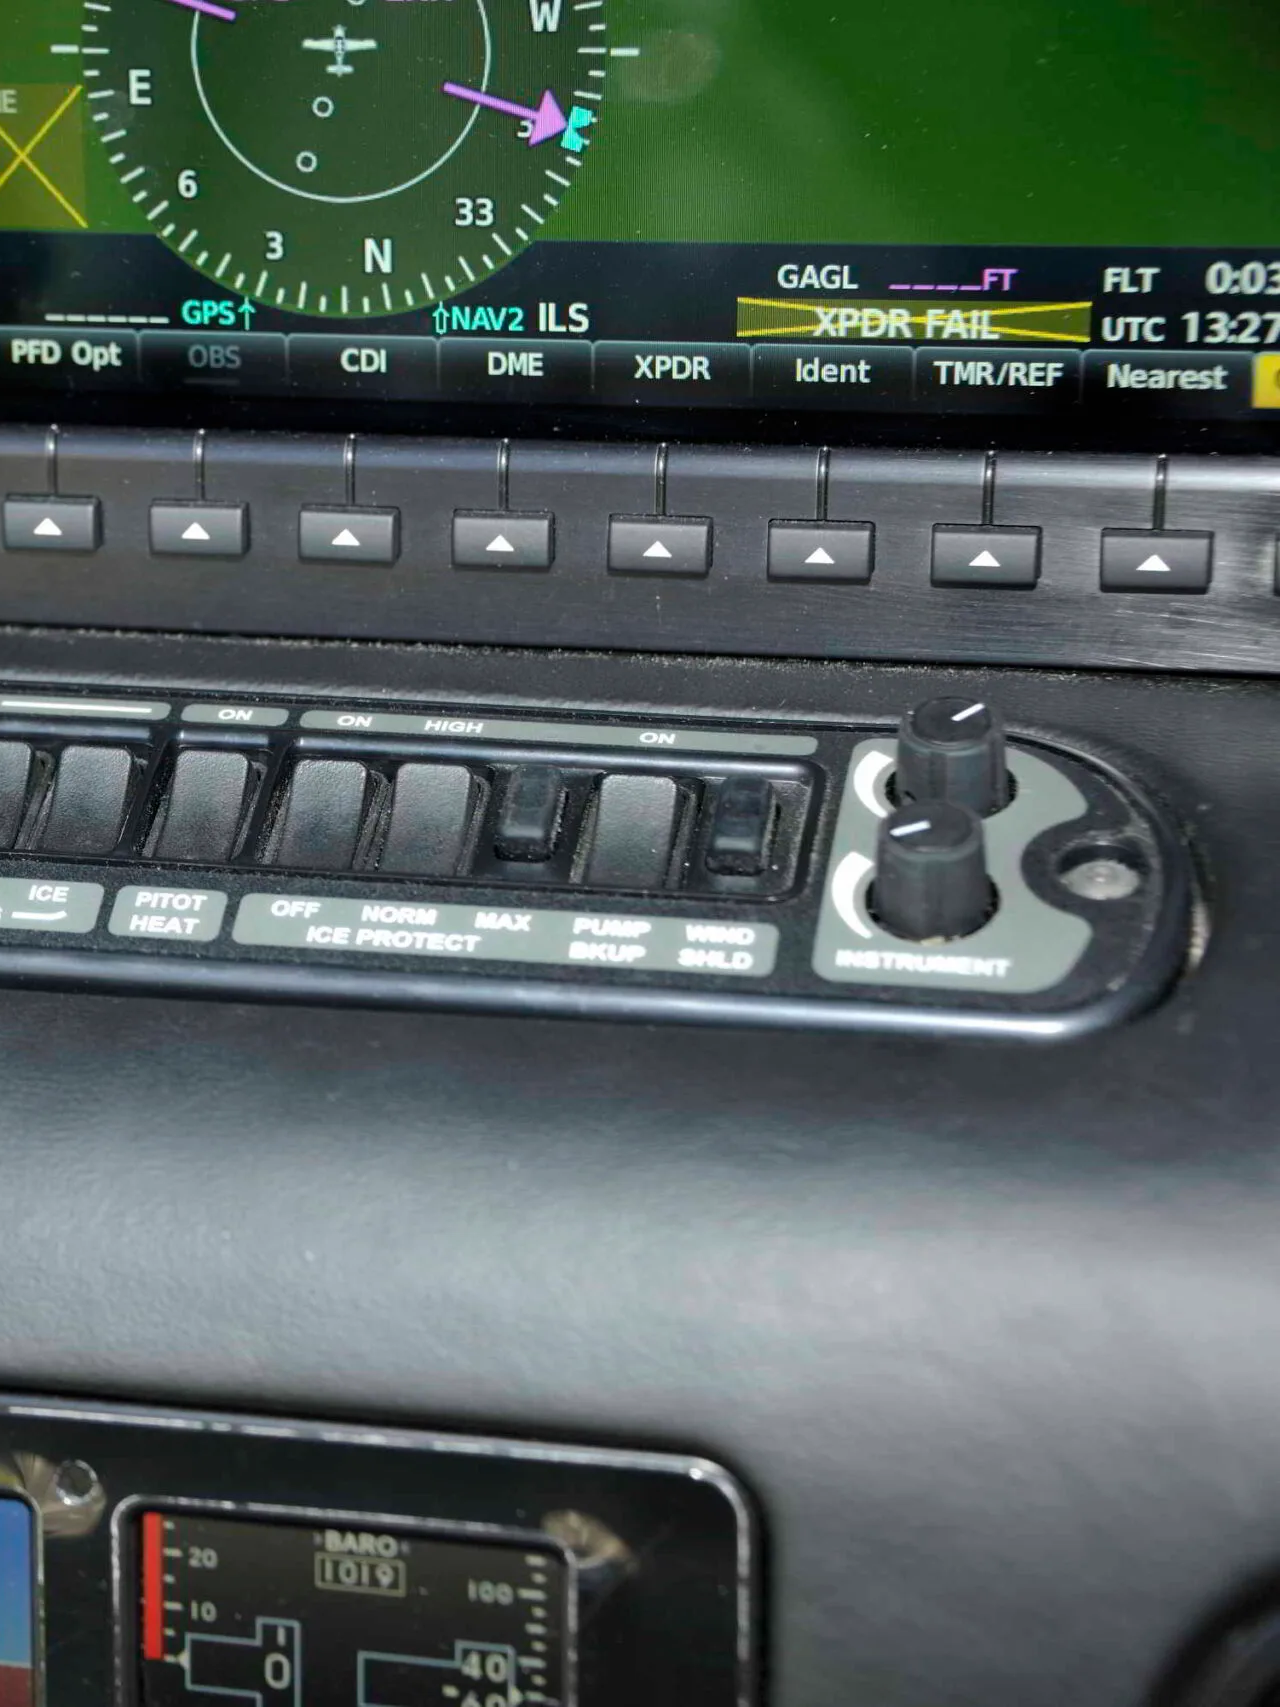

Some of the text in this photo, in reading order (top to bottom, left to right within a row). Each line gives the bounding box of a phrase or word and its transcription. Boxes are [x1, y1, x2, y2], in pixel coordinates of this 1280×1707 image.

[528, 0, 562, 32] W
[129, 69, 153, 106] E
[177, 170, 199, 199] 6
[455, 198, 495, 227] 33
[264, 231, 285, 261] 3
[363, 238, 393, 274] N
[777, 264, 859, 291] GAGL
[1103, 267, 1161, 294] FLT
[181, 302, 236, 325] GPS
[451, 308, 524, 332] NAV2
[538, 303, 590, 333] ILS
[812, 305, 1002, 341] XPDR FAIL
[1102, 316, 1167, 344] UTC
[11, 339, 122, 369] PFD Opt
[187, 345, 242, 369] OBS
[340, 348, 388, 375] CDI
[487, 351, 545, 378] DME
[634, 355, 711, 381] XPDR
[795, 357, 871, 385] Ident
[933, 360, 1064, 389] TMR/REF
[1107, 363, 1229, 391] Nearest
[218, 708, 254, 722] ON
[336, 714, 373, 729] ON
[423, 718, 485, 734] HIGH
[639, 730, 677, 746] ON
[28, 884, 70, 903] ICE
[134, 891, 208, 912] PITOT
[270, 900, 322, 919] OFF
[360, 905, 438, 926] NORM
[475, 911, 533, 932] MAX
[129, 914, 200, 935] HEAT
[572, 917, 652, 938] PUMP
[306, 925, 482, 954] ICE PROTECT
[568, 941, 647, 963] BKUP
[835, 948, 1012, 978] INSTRUMENT
[323, 1530, 398, 1557] BARO
[188, 1546, 219, 1569] 20
[321, 1561, 396, 1588] 1019
[466, 1578, 515, 1606] 100
[190, 1600, 218, 1623] 10
